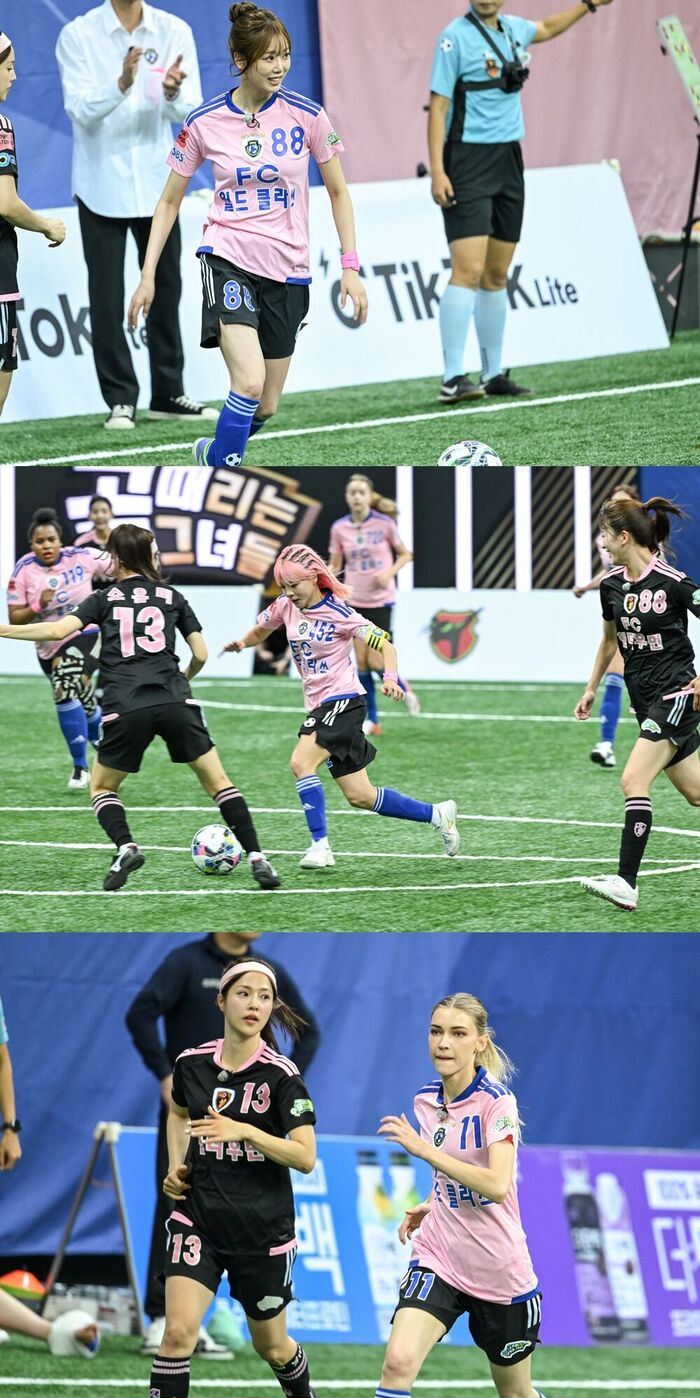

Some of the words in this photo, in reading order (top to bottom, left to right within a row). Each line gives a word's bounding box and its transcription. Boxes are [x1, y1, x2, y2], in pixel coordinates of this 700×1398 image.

[270, 125, 305, 158] 88
[236, 164, 280, 187] FC
[219, 188, 249, 212] 월드
[534, 274, 579, 308] Lite
[61, 566, 85, 586] 119
[638, 589, 667, 614] 88
[112, 606, 167, 658] 13
[309, 620, 336, 642] 452
[620, 616, 641, 633] FC
[239, 1082, 272, 1114] 13
[459, 1114, 483, 1151] 11
[171, 1233, 202, 1266] 13
[404, 1271, 436, 1301] 11
